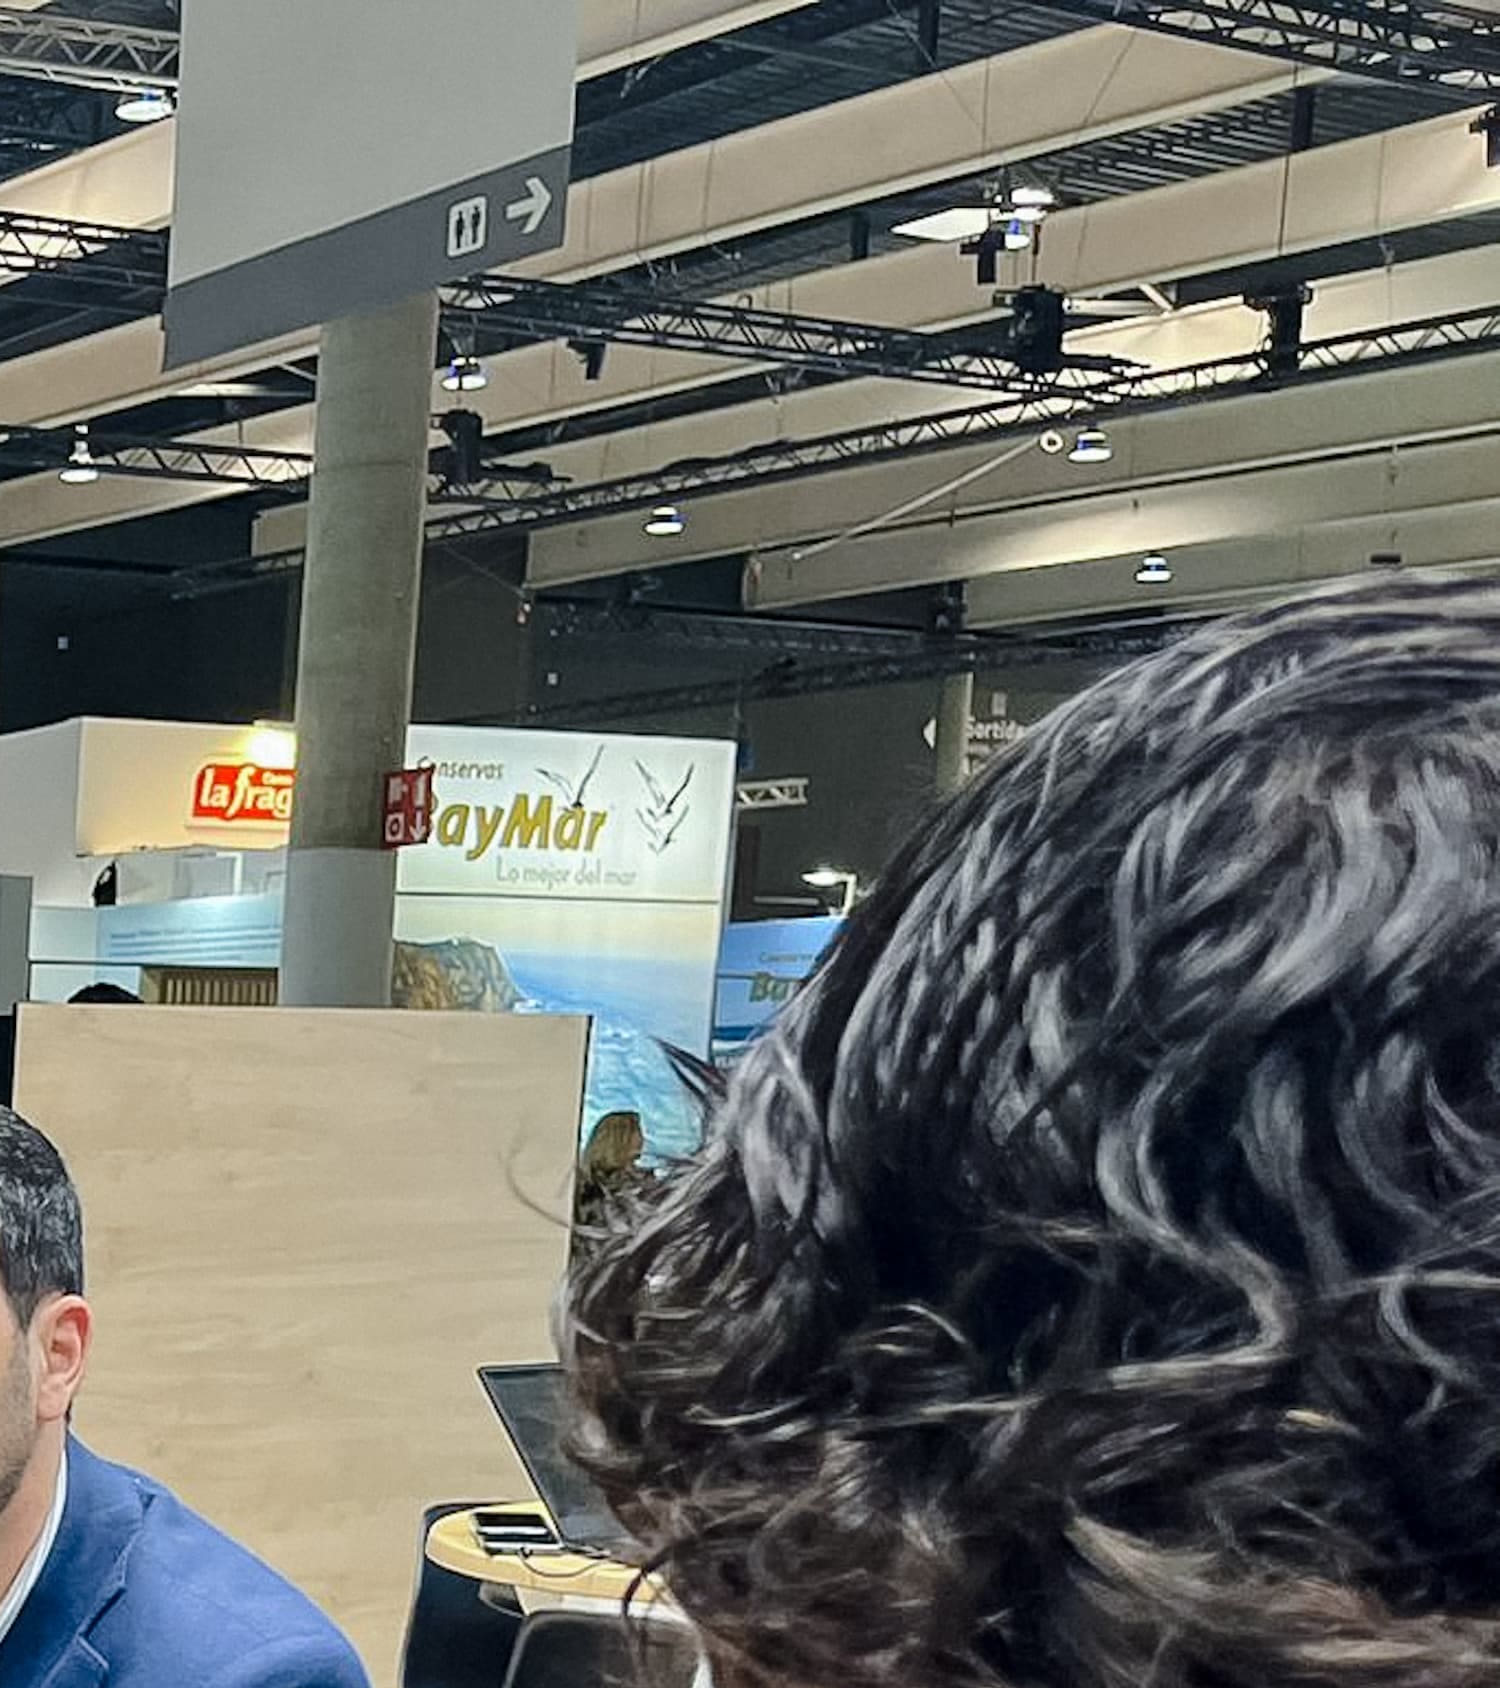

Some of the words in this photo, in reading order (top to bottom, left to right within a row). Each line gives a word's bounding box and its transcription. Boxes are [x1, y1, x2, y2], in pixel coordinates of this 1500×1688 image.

[416, 755, 505, 779] Cnservas
[224, 765, 294, 819] frag
[429, 793, 608, 861] ayMar
[523, 860, 571, 889] mejor
[575, 858, 602, 884] del
